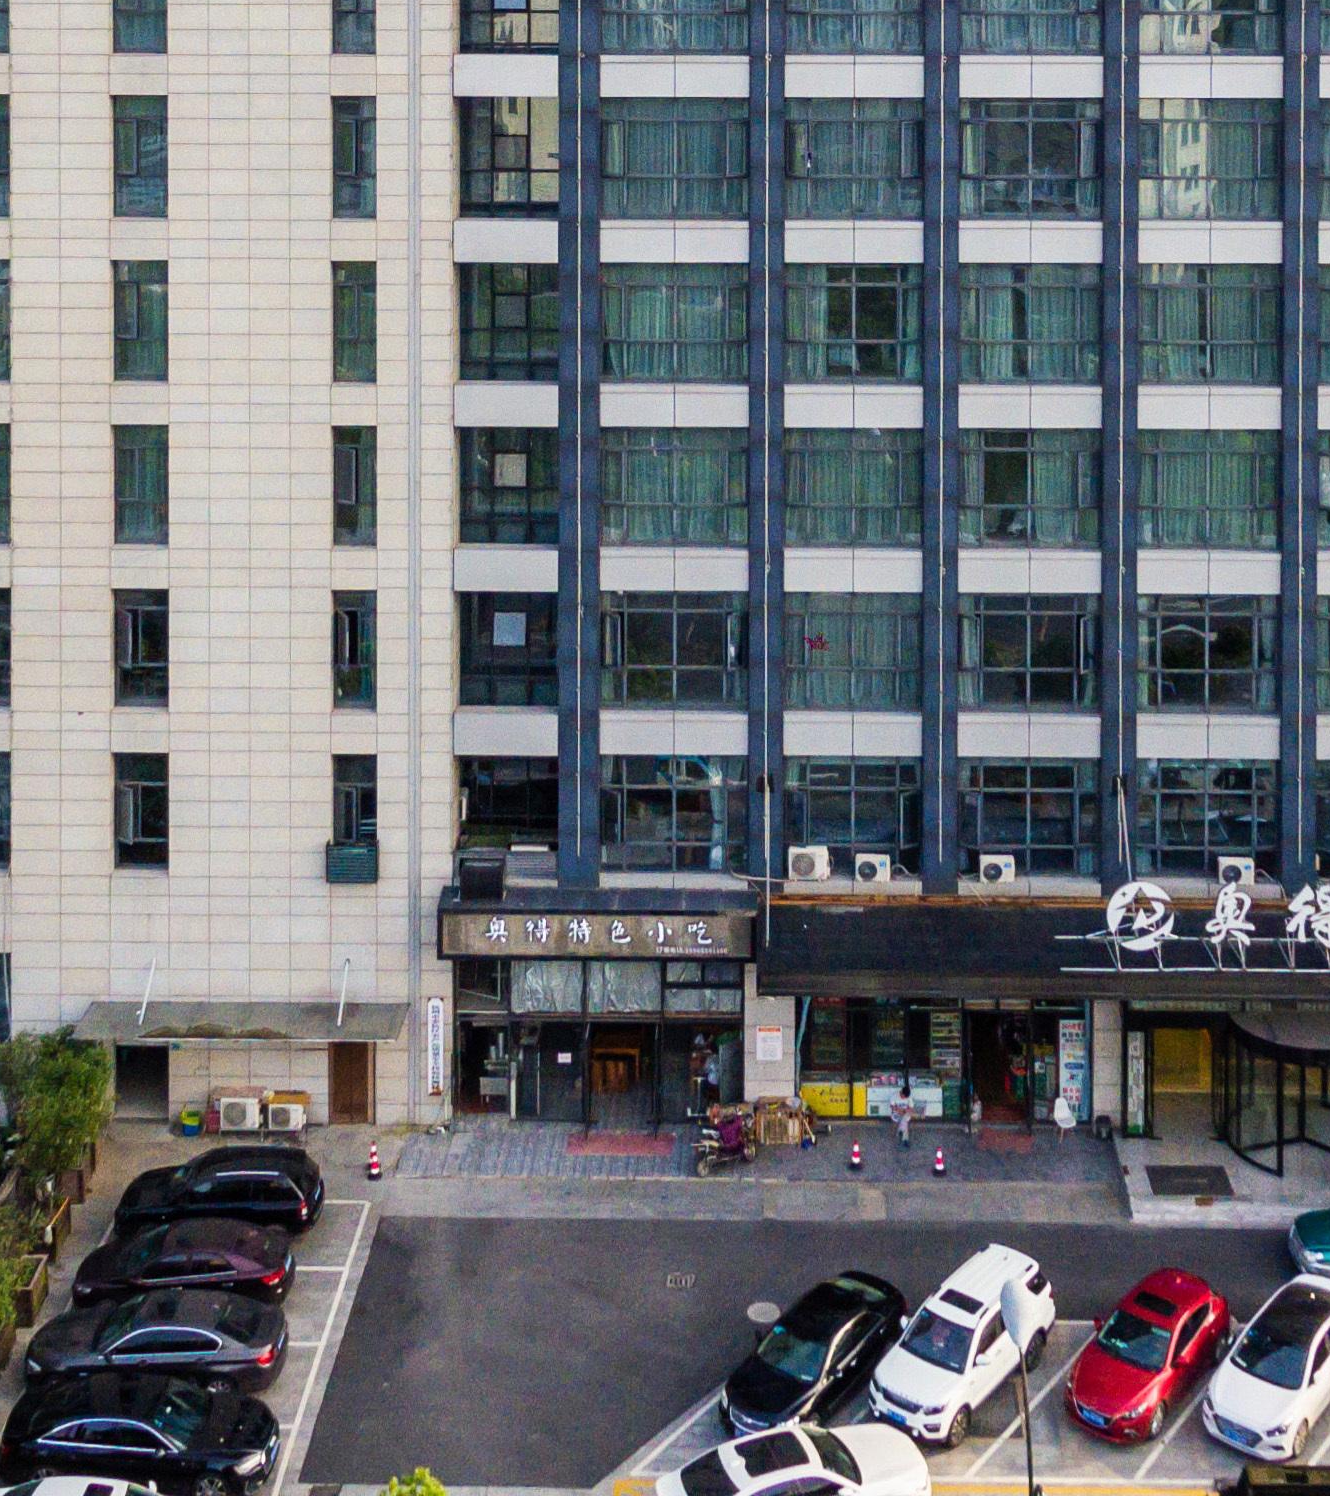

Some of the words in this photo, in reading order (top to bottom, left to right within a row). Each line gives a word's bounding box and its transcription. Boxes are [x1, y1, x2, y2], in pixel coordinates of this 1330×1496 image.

[485, 916, 713, 944] 奥得特色小吃
